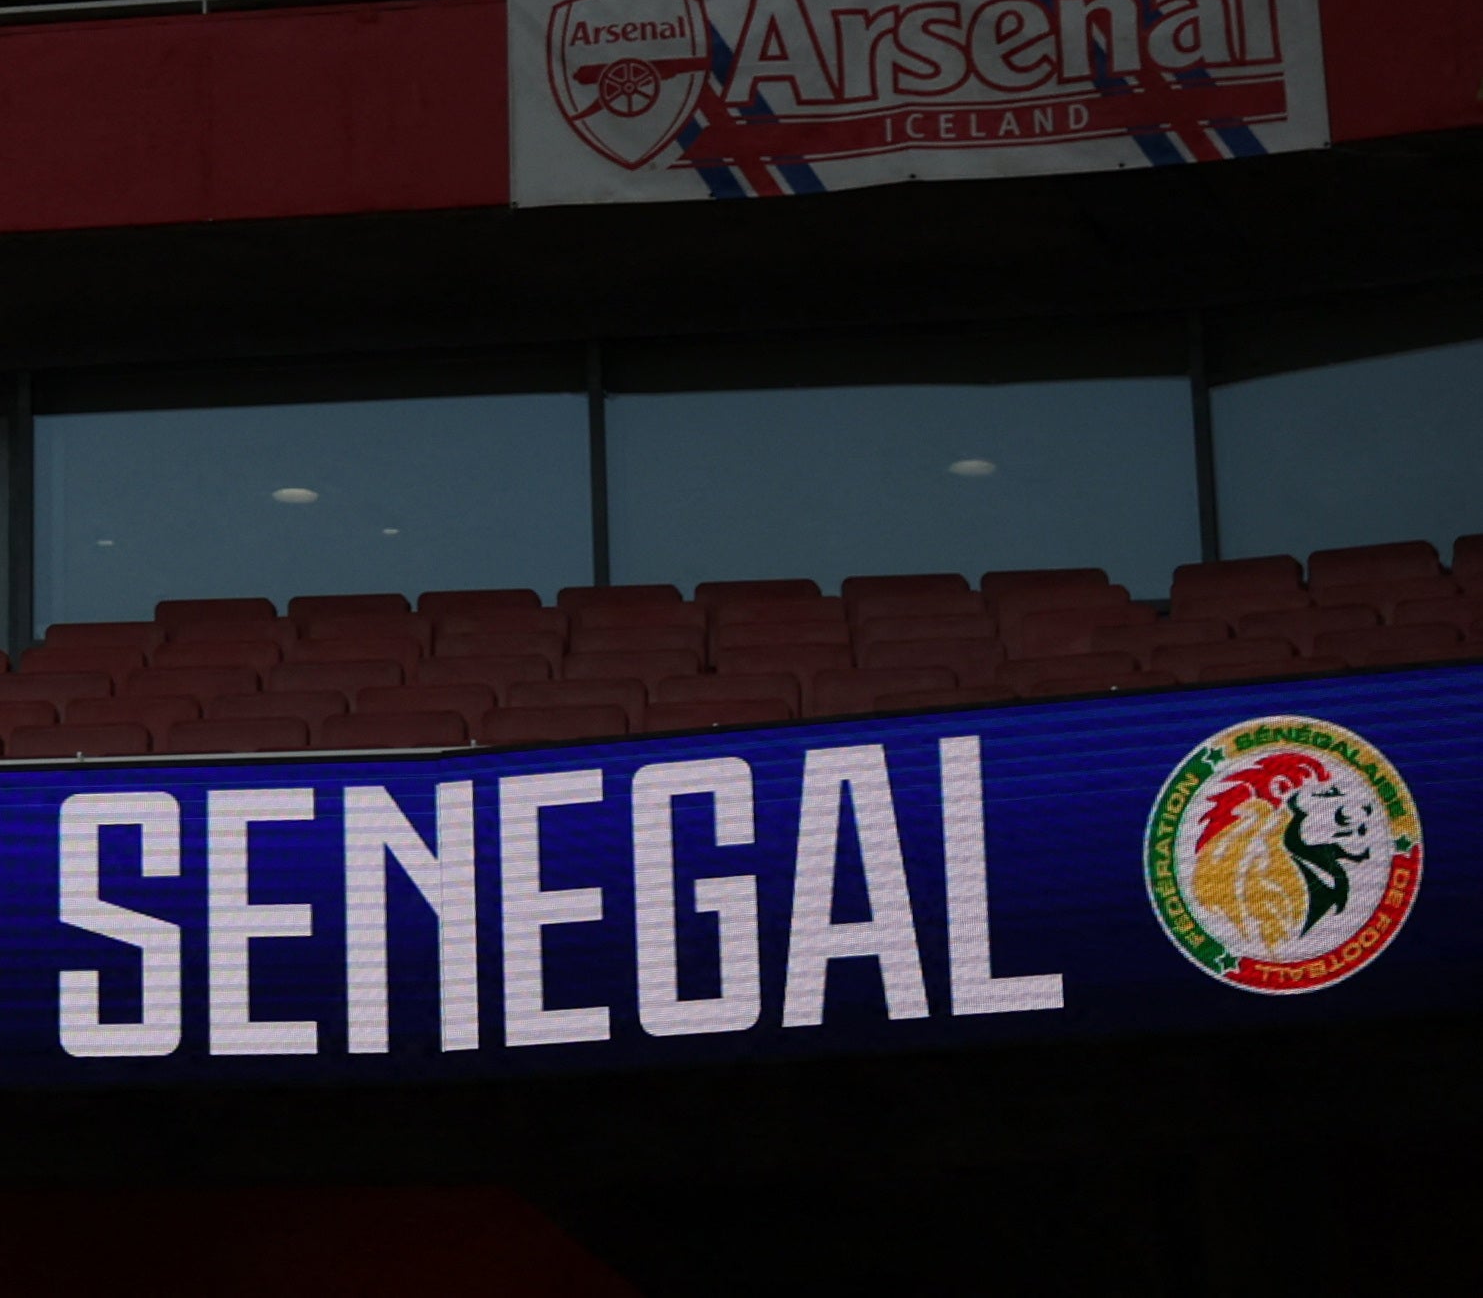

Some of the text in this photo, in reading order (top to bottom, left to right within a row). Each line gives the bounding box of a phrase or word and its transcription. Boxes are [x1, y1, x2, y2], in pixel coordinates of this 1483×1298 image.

[569, 15, 686, 48] Arsenal
[882, 102, 1091, 145] ICELAND
[57, 735, 1065, 1059] SENEGAL
[1389, 868, 1412, 908] DE
[1254, 911, 1391, 981] FOOTBALL
